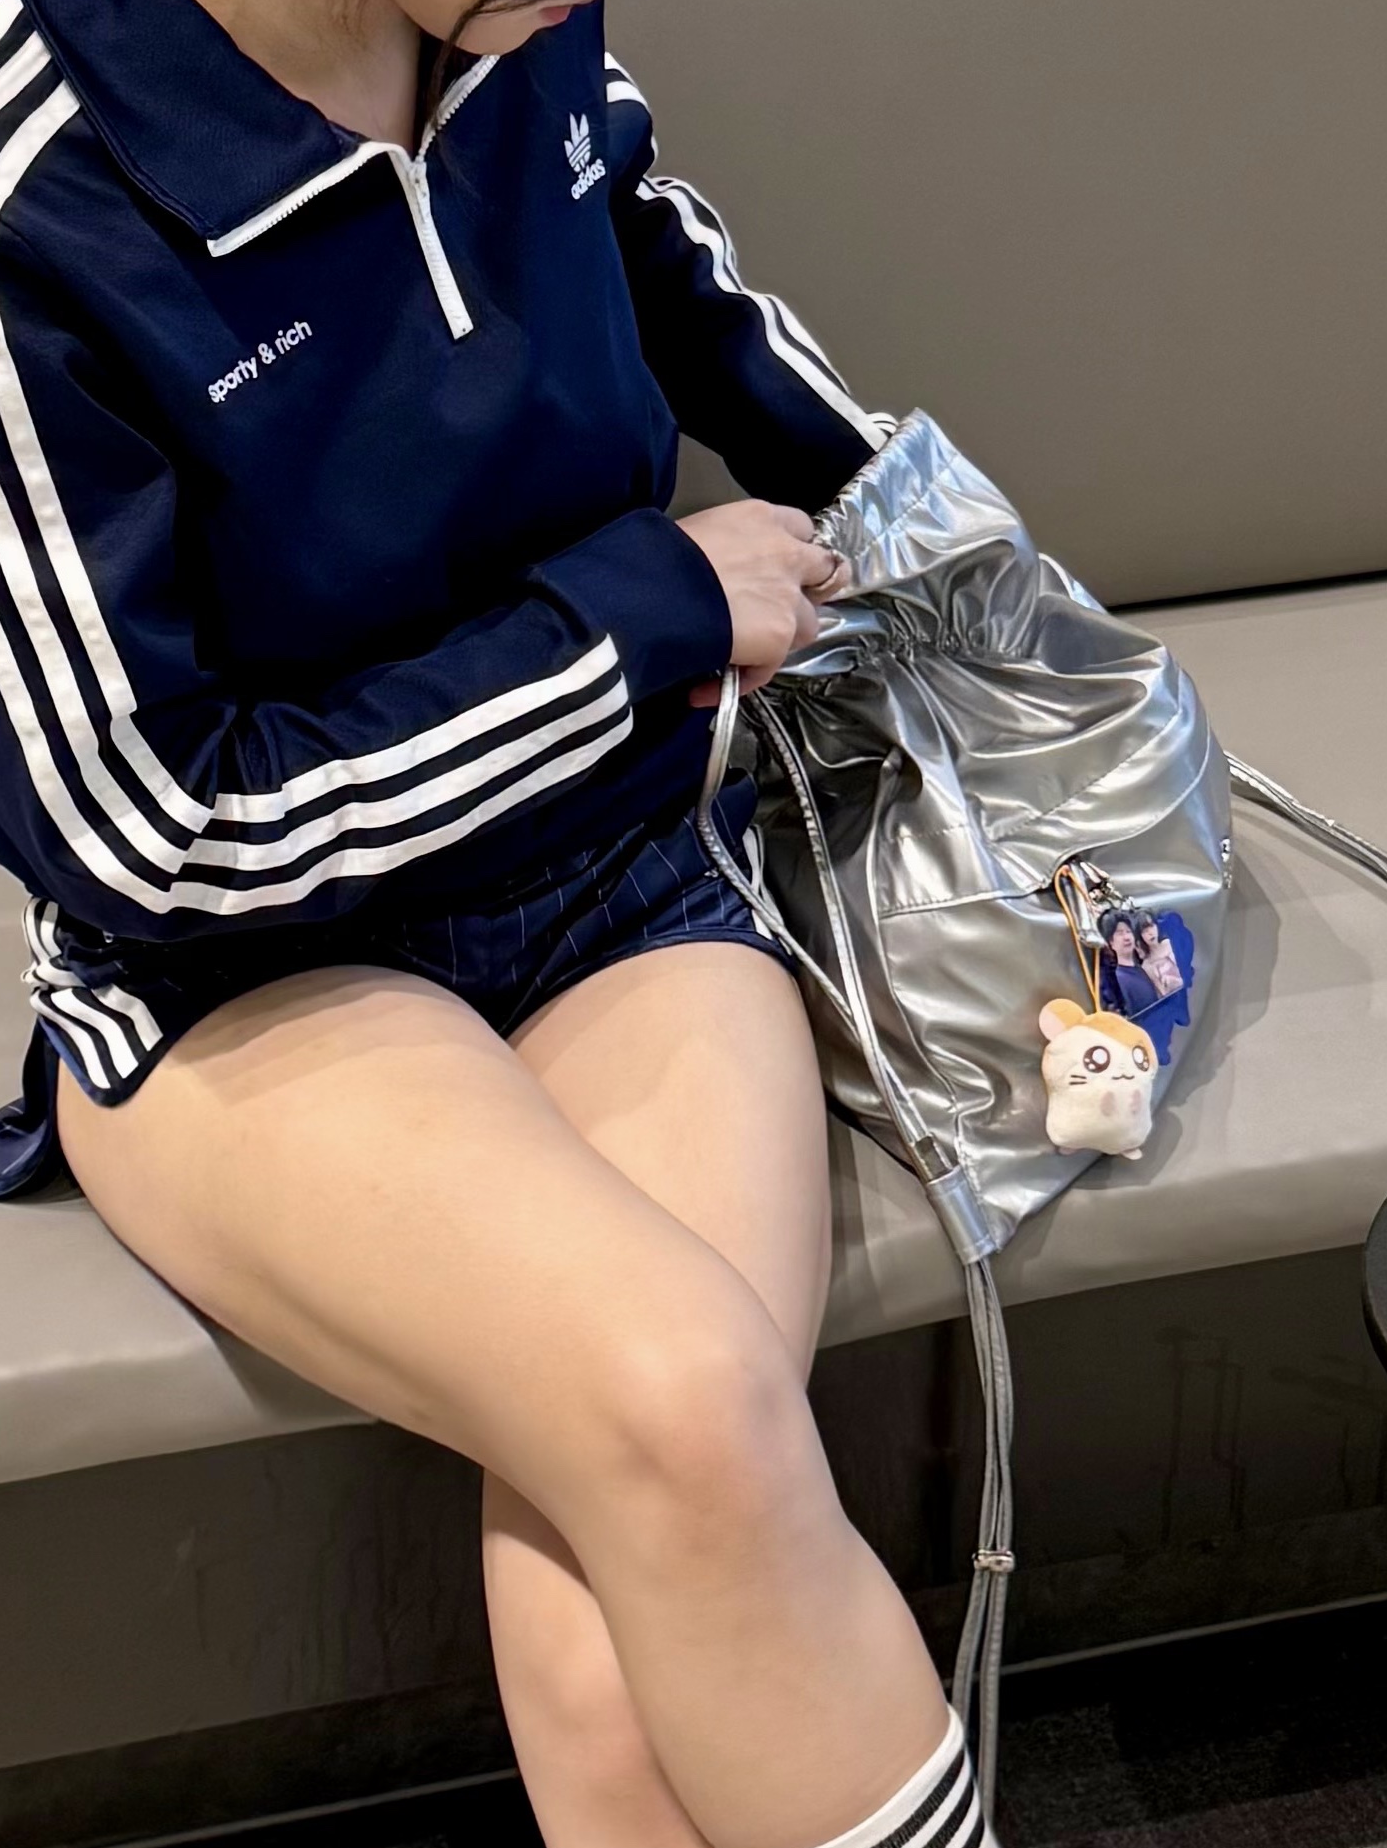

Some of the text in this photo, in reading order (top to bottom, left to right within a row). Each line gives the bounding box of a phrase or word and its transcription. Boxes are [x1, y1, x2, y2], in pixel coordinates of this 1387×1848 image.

[571, 158, 606, 200] adidas
[208, 321, 313, 403] sporty & rich
